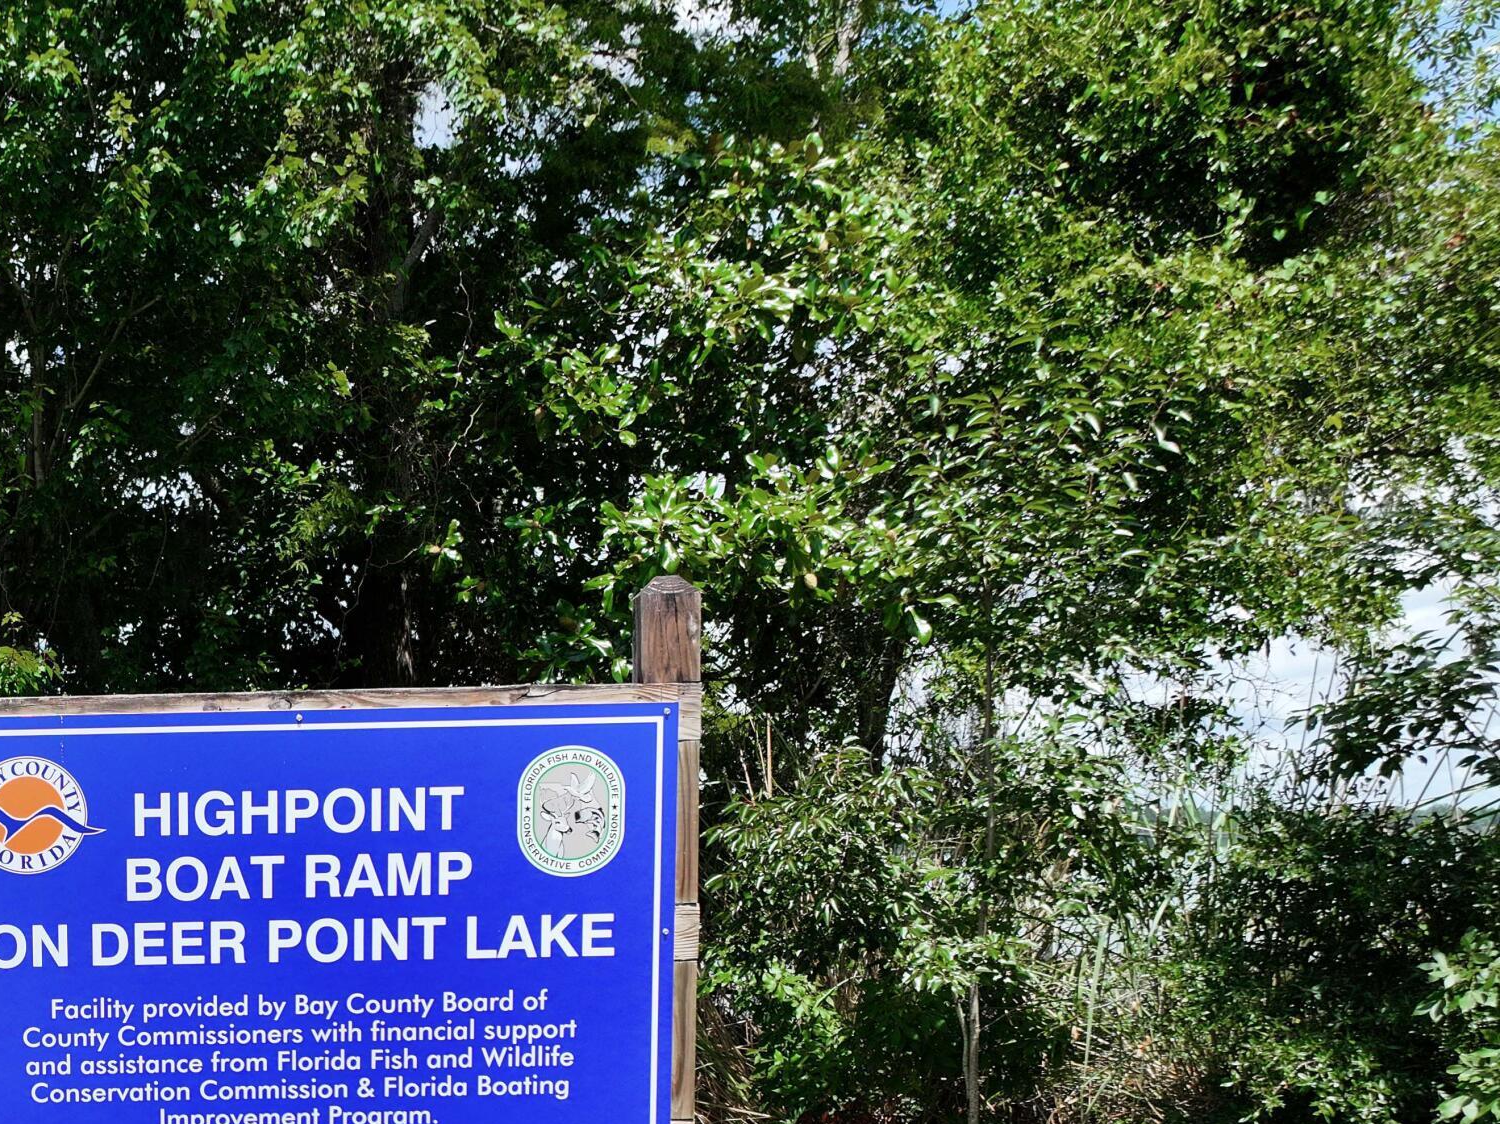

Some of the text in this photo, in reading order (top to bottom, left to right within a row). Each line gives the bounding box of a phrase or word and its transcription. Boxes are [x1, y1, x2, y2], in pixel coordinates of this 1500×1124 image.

[10, 761, 82, 813] COUNTY
[524, 753, 619, 801] FLORIDA FISH AND WILDLIFE
[133, 786, 465, 837] HIGHPOINT
[523, 813, 619, 870] CONSERVATIVE COMMISSION
[125, 851, 473, 902] BOAT RAMP
[91, 920, 246, 966] DEER
[268, 916, 446, 964] POINT
[466, 913, 616, 959] LAKE
[50, 988, 549, 1024] Facility provided by Bay County Board of
[22, 1018, 577, 1052] County Commissioners with financial support
[25, 1044, 575, 1076] and assistance from Florida Fish and Wildlife
[30, 1074, 570, 1104] Conservation Commission & Florida Boating
